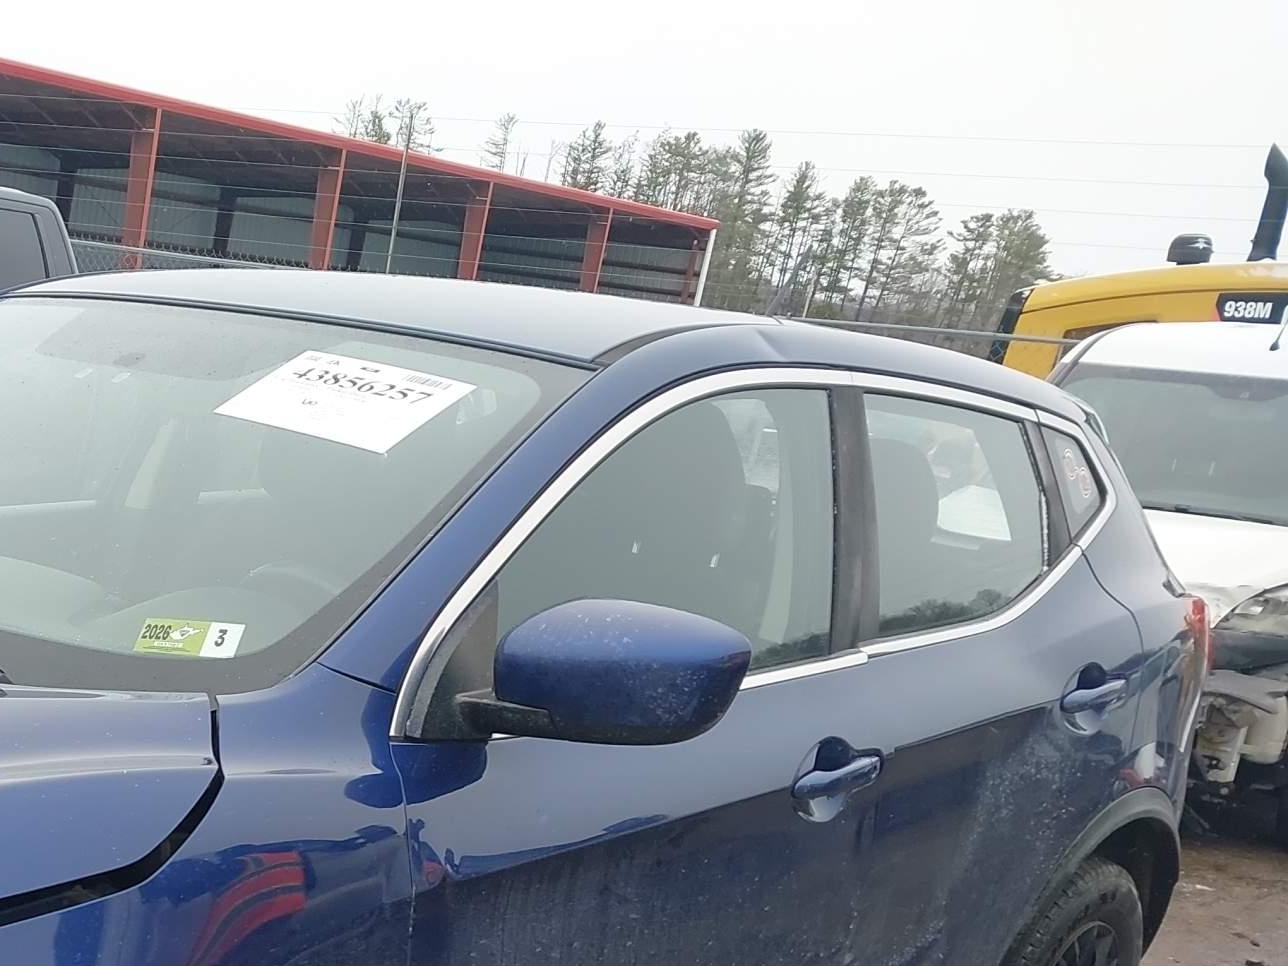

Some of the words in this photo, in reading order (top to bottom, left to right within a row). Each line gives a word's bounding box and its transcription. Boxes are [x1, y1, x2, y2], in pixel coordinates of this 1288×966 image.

[1223, 300, 1274, 319] 938M
[292, 367, 434, 404] 43856257
[141, 623, 172, 641] 2026
[214, 628, 228, 648] 3
